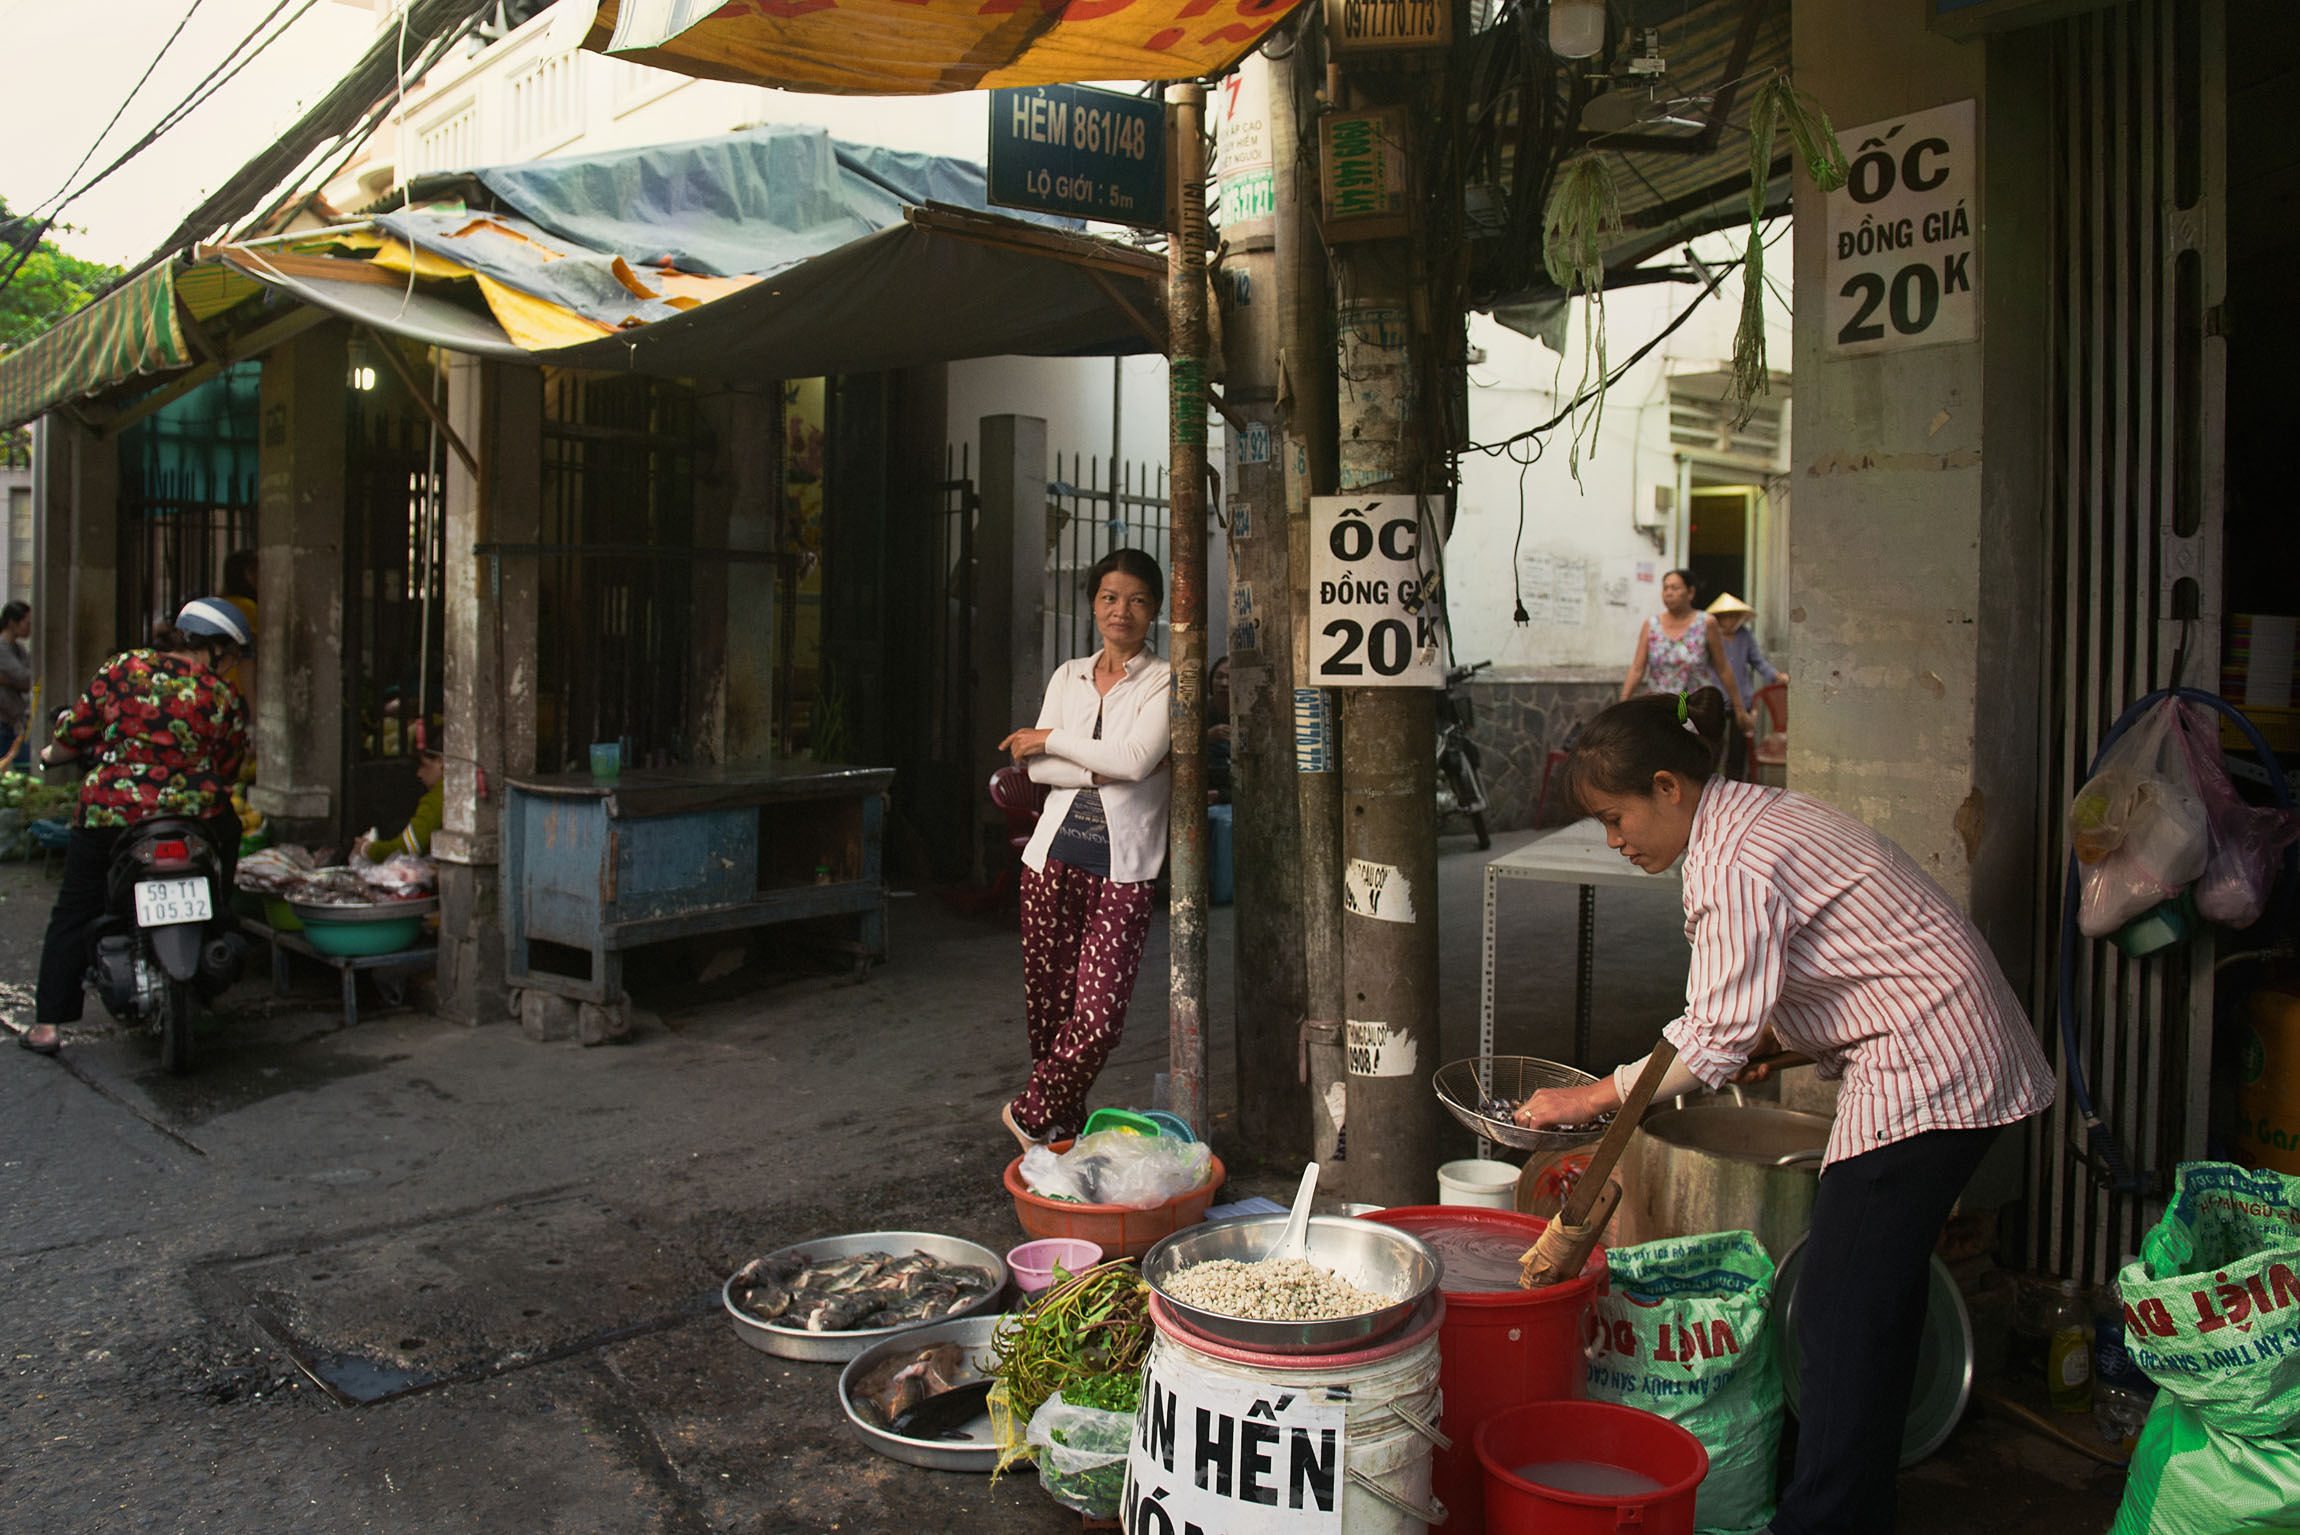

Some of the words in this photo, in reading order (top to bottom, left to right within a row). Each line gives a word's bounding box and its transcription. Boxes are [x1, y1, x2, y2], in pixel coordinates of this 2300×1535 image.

[1012, 87, 1067, 146] HẺM
[1073, 106, 1145, 161] 861/48
[1026, 168, 1051, 199] LỘ
[1055, 173, 1093, 204] GIỚI
[1109, 184, 1134, 209] 5m
[1847, 123, 1950, 204] ỐC
[1837, 213, 1914, 260] ĐỒNG
[1923, 198, 1970, 244] GIÁ
[1330, 502, 1419, 562] ỐC
[1320, 570, 1389, 605] ĐỒNG
[2191, 1263, 2300, 1334] VIỆT
[1653, 1311, 1740, 1373] VIỆT
[1195, 1392, 1337, 1513] HẾN
